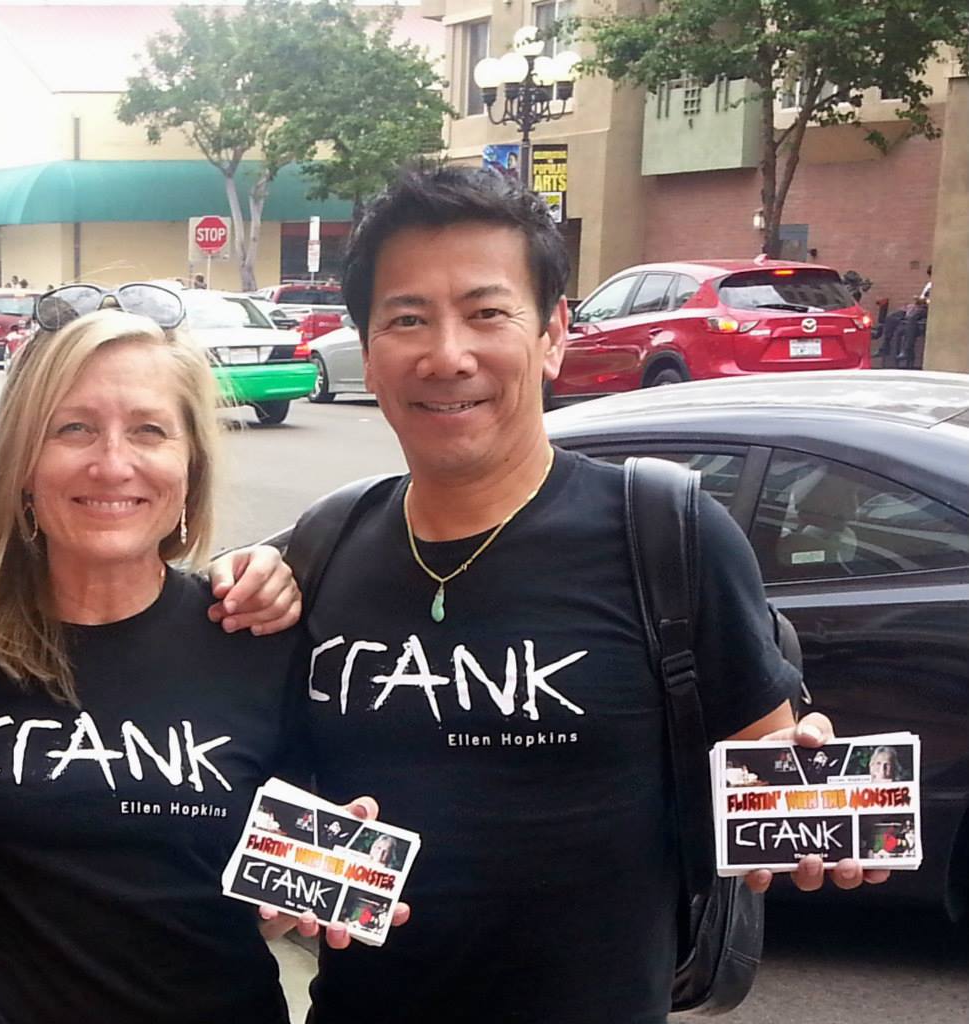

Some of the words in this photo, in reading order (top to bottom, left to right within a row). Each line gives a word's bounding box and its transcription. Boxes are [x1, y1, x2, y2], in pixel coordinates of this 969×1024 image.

[534, 174, 567, 192] ARTS
[196, 227, 226, 242] STOP
[448, 733, 491, 746] Ellen
[501, 732, 578, 747] Hopkins
[726, 789, 781, 813] FLIRTIN'
[849, 786, 911, 811] MONSTER
[120, 801, 161, 814] Ellen
[170, 802, 227, 818] Hopkins
[344, 862, 397, 892] MONSTER
